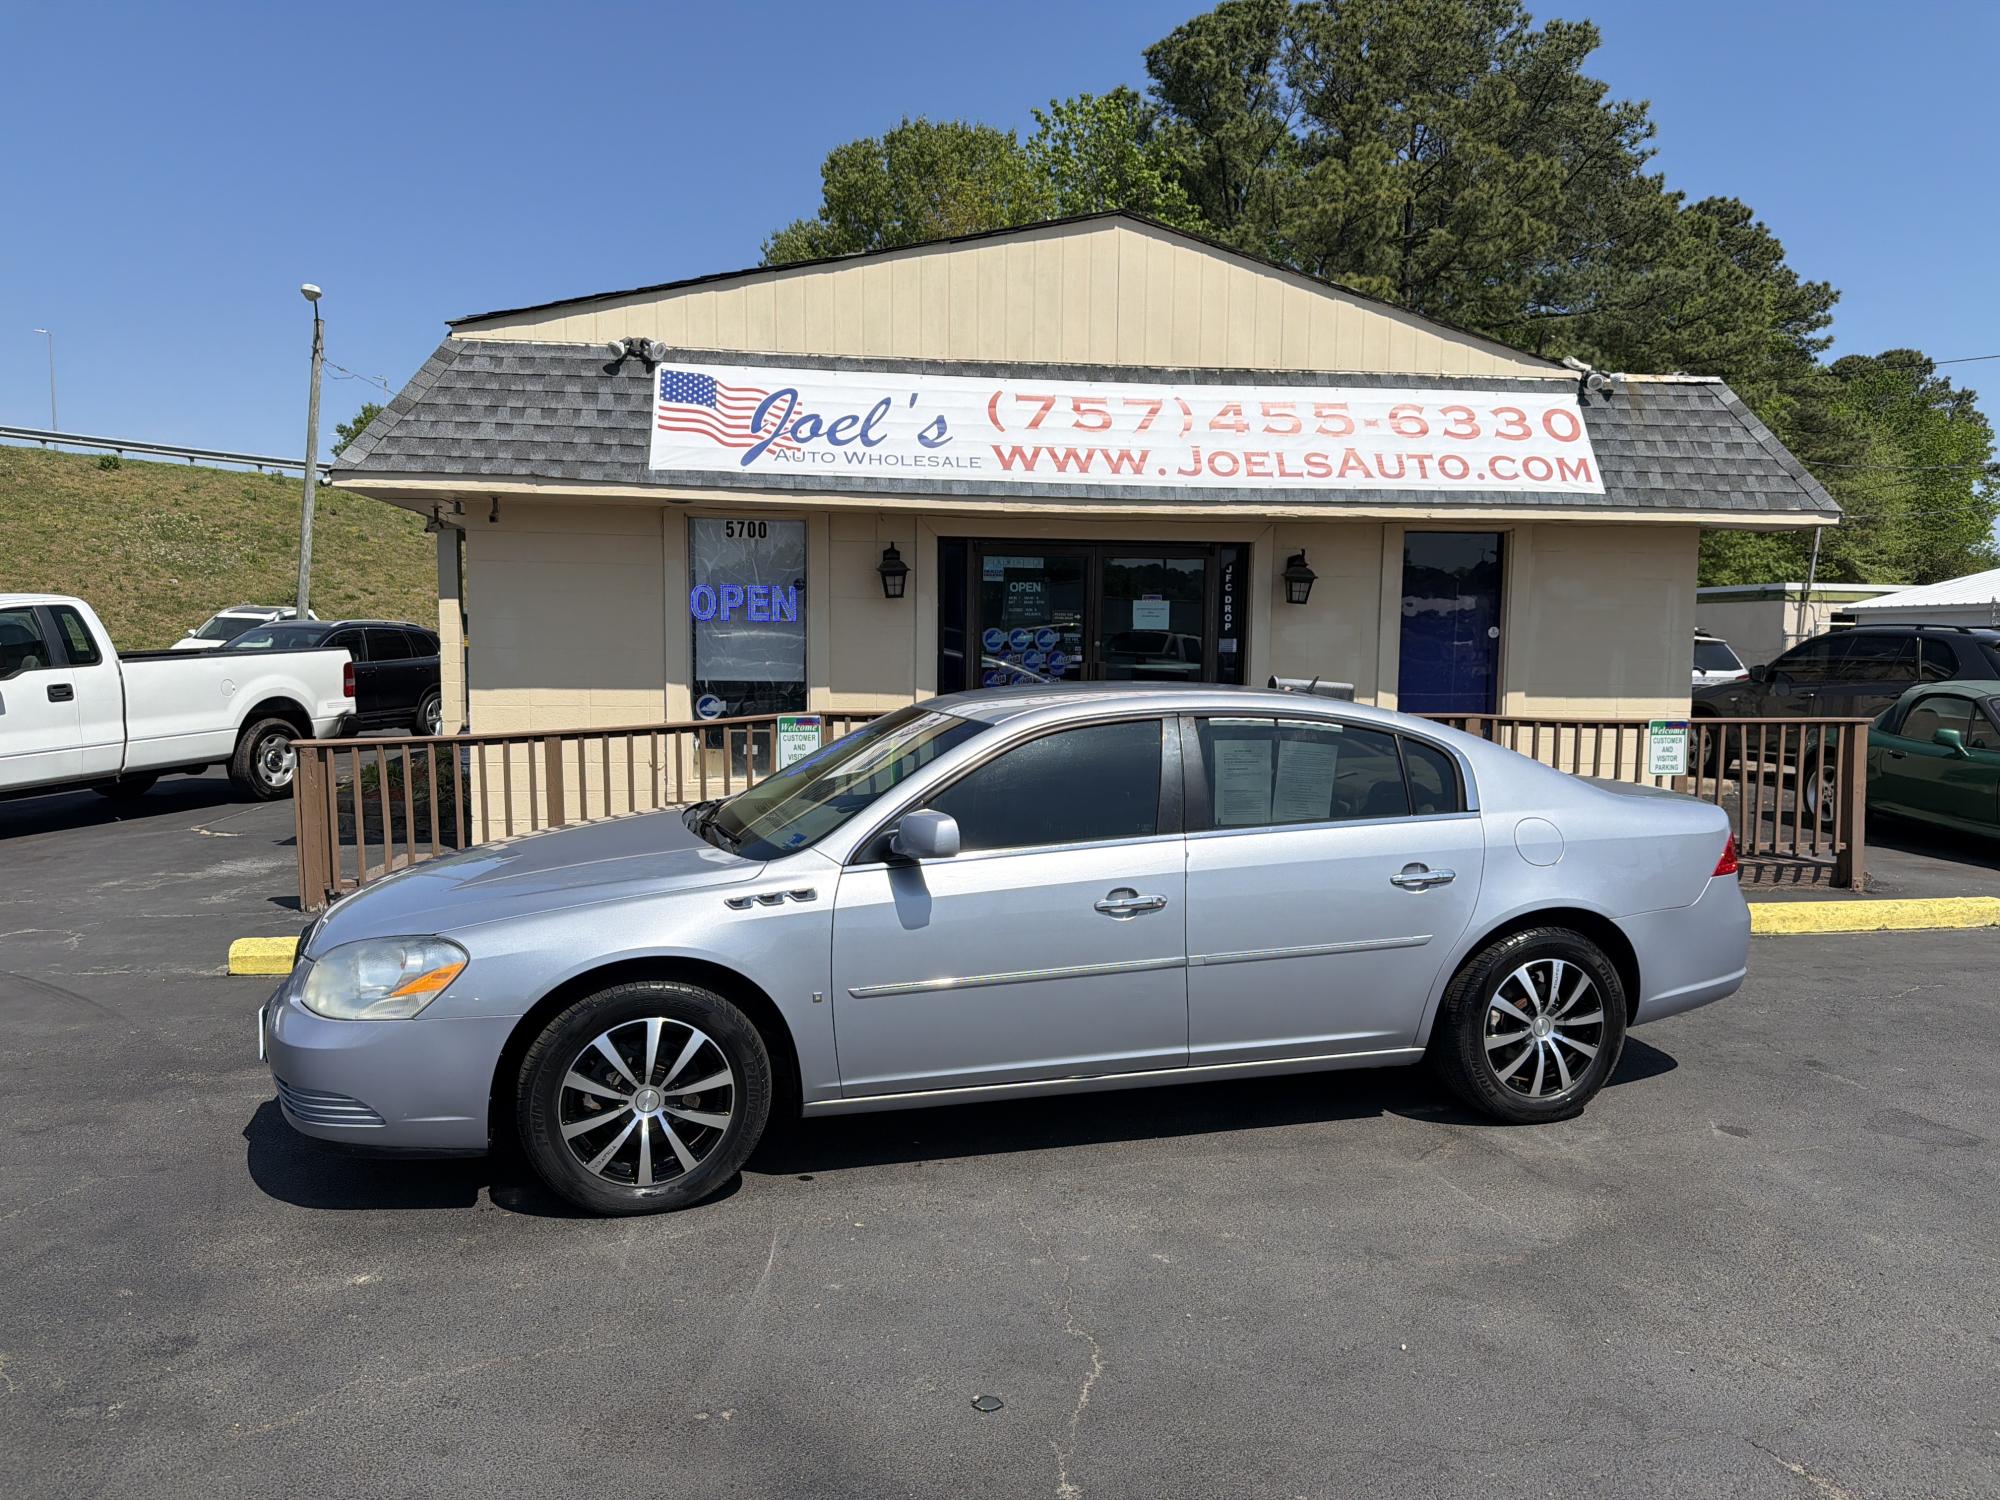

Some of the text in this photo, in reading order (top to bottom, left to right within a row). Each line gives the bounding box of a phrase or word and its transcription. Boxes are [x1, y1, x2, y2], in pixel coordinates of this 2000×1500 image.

[740, 387, 953, 466] Joel's
[774, 448, 982, 469] AUTO WHOLESALE
[725, 520, 767, 539] 5700
[1009, 581, 1041, 593] OPEN
[690, 583, 797, 622] OPEN
[1224, 595, 1232, 631] DROP
[781, 722, 817, 732] Welcome
[1652, 726, 1685, 735] Welcome
